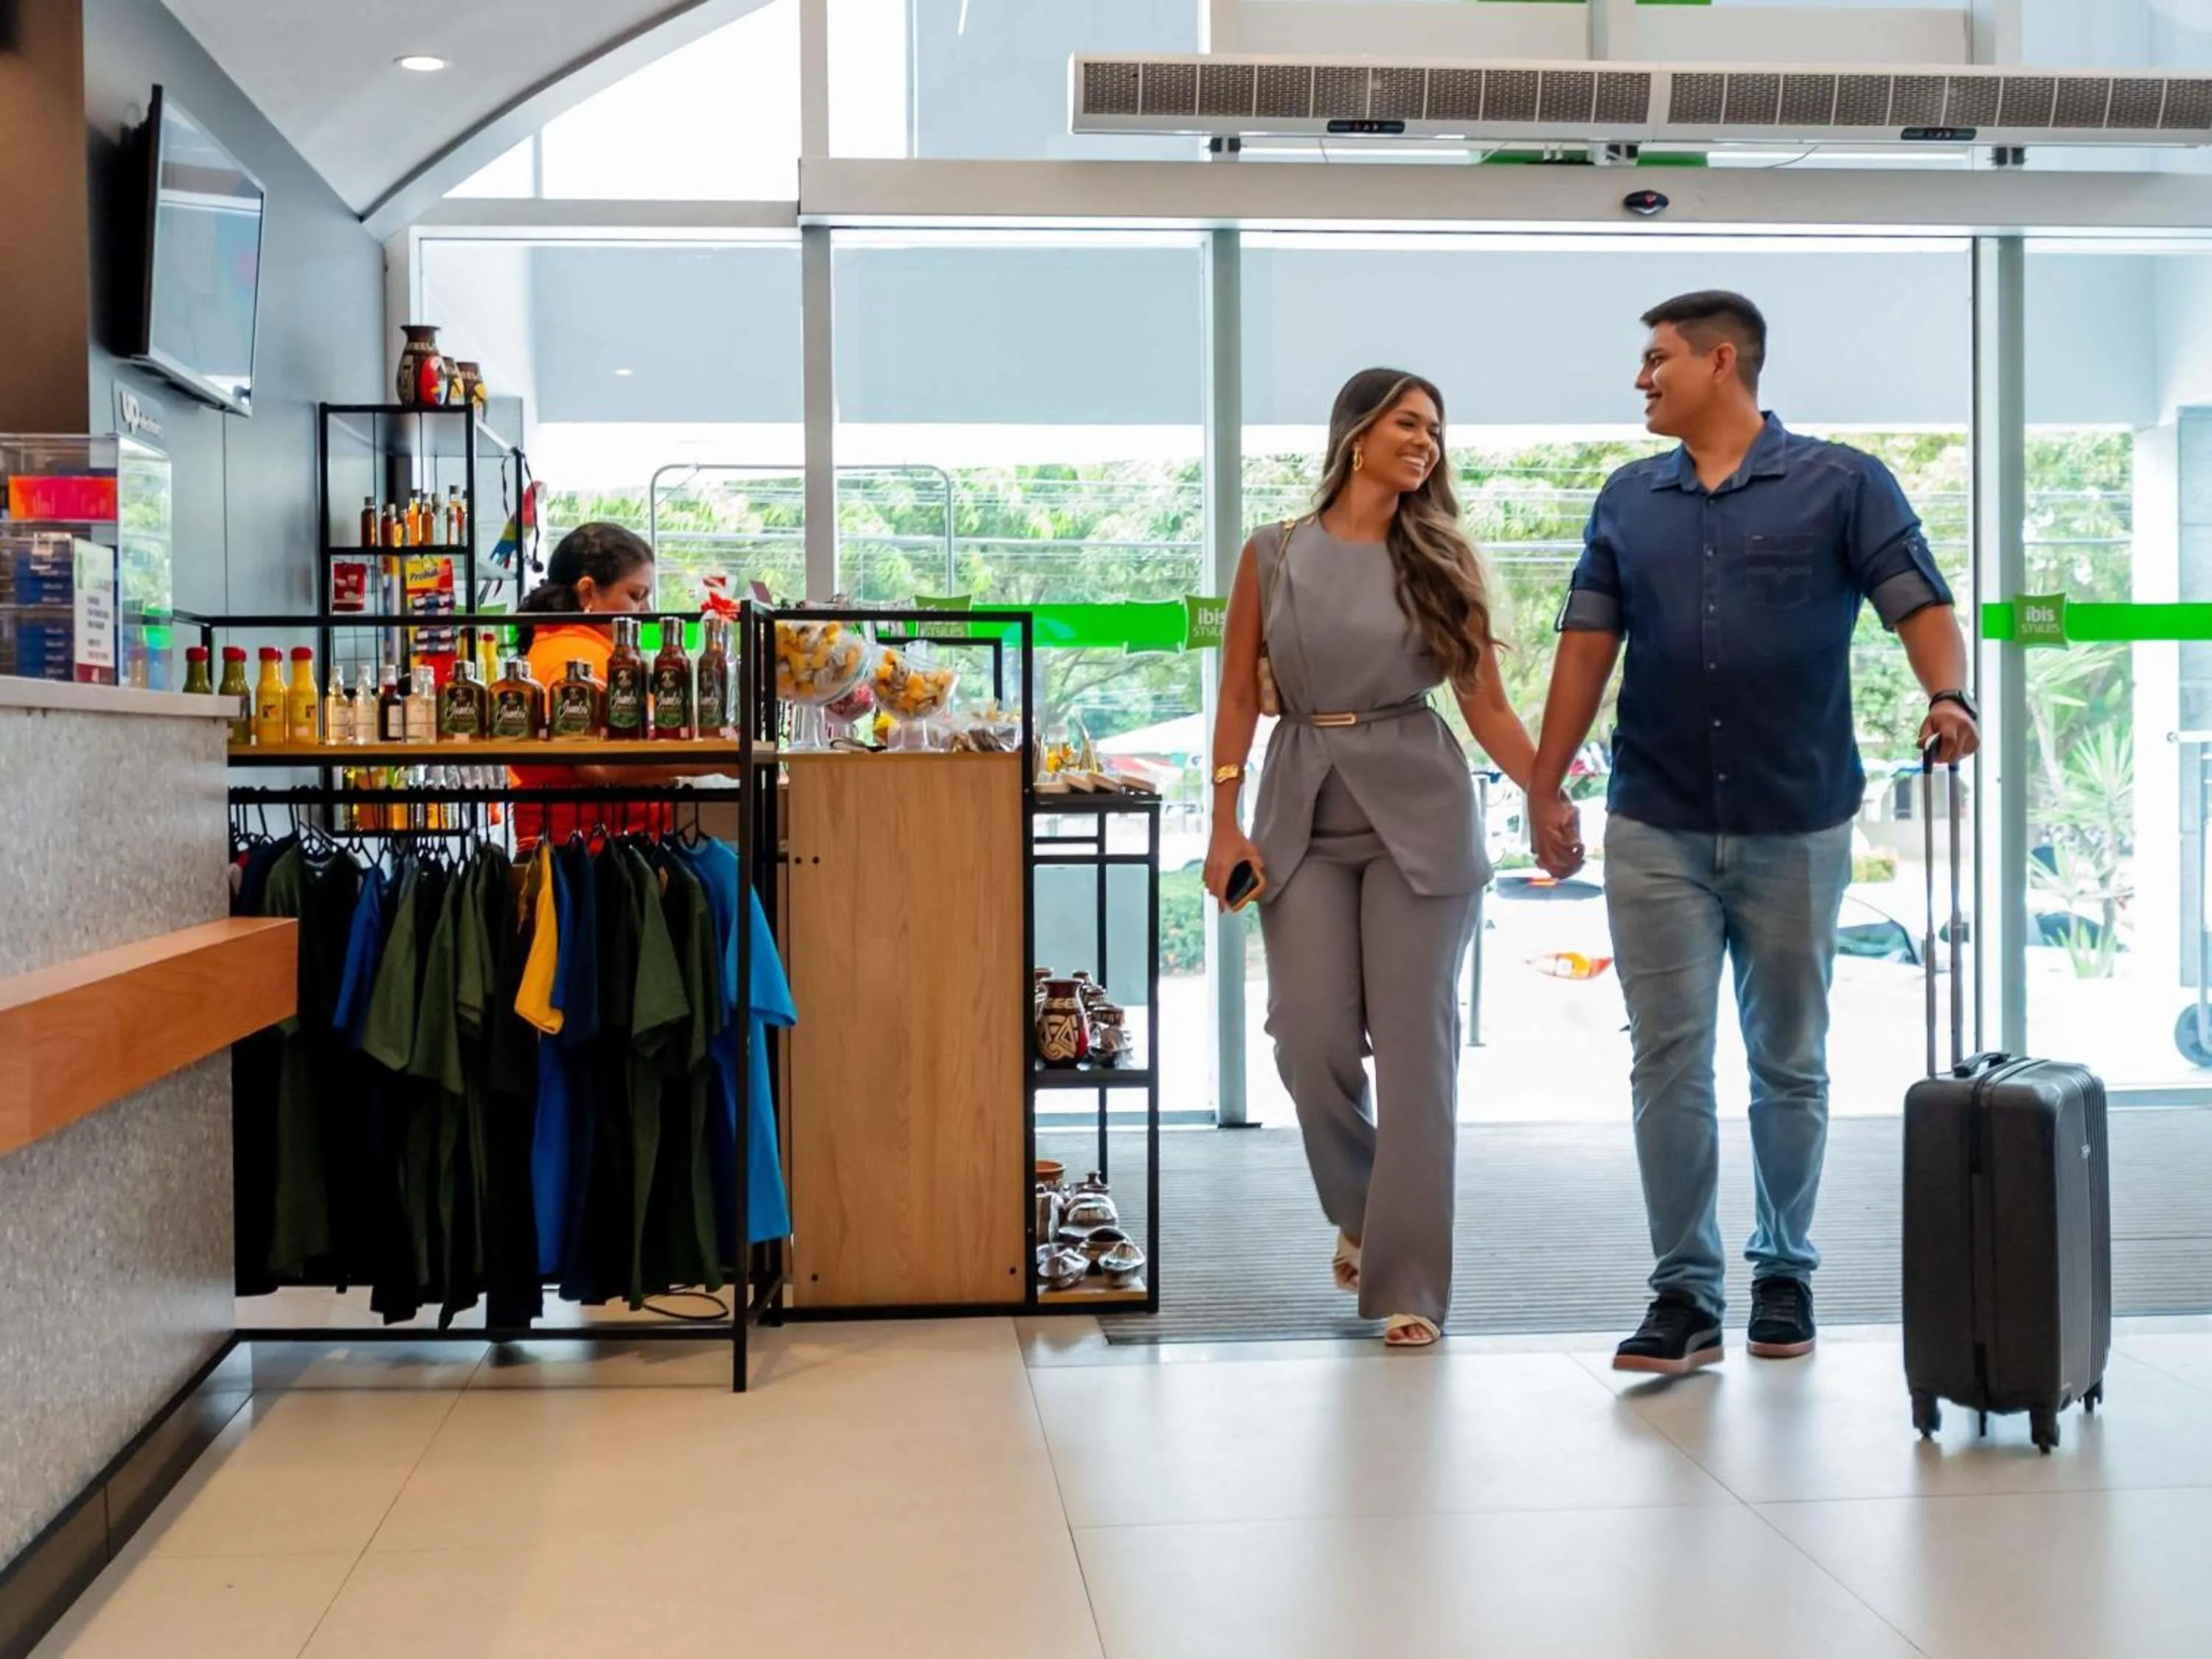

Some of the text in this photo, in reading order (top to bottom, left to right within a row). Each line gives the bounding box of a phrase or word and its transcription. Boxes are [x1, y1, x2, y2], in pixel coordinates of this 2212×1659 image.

[1198, 607, 1227, 625] ibis
[2026, 605, 2055, 622] ibis
[2021, 623, 2060, 633] STYLES
